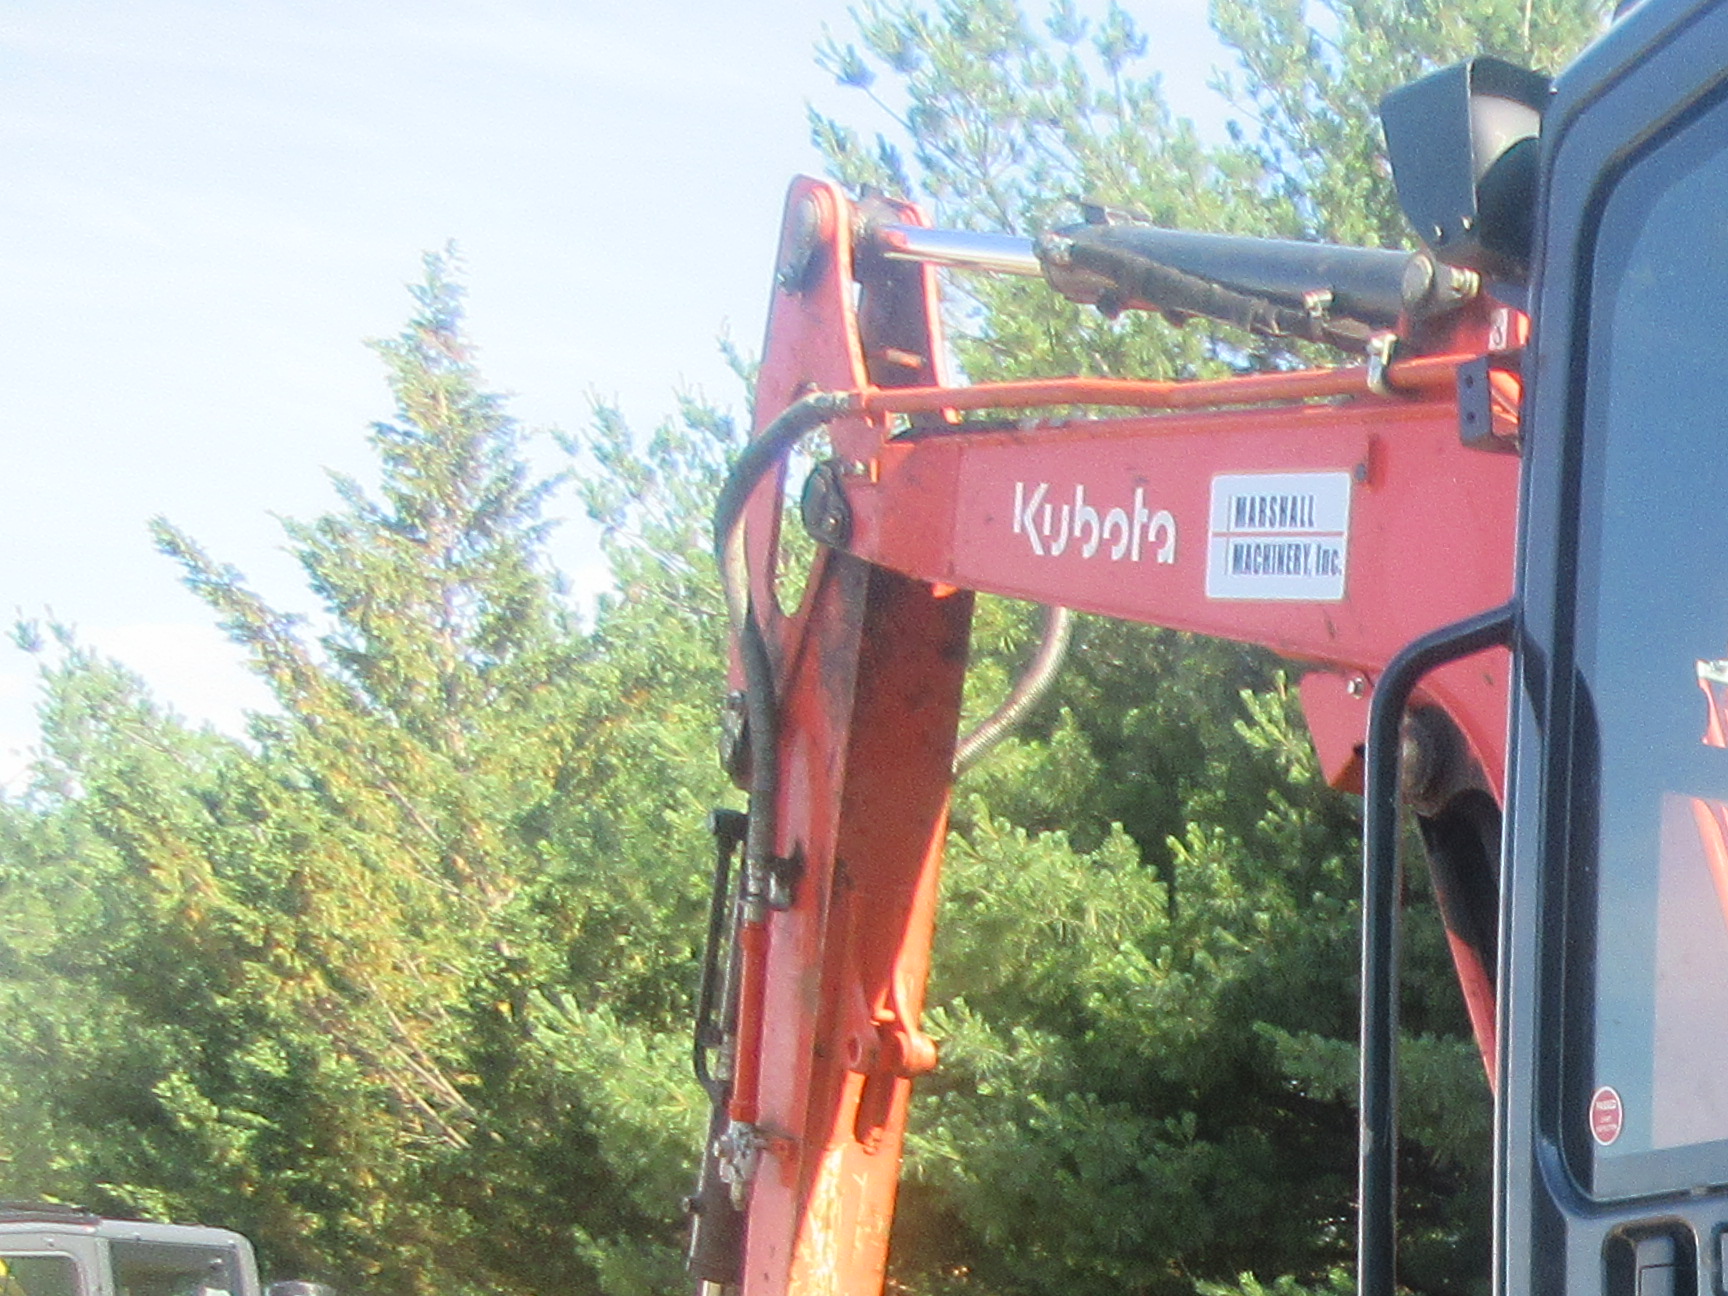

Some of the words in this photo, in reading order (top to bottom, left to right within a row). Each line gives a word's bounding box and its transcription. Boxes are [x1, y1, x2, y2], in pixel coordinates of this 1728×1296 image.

[1013, 480, 1177, 564] Kubota
[1235, 495, 1315, 528] MARSHALL
[1316, 543, 1342, 576] Inc.
